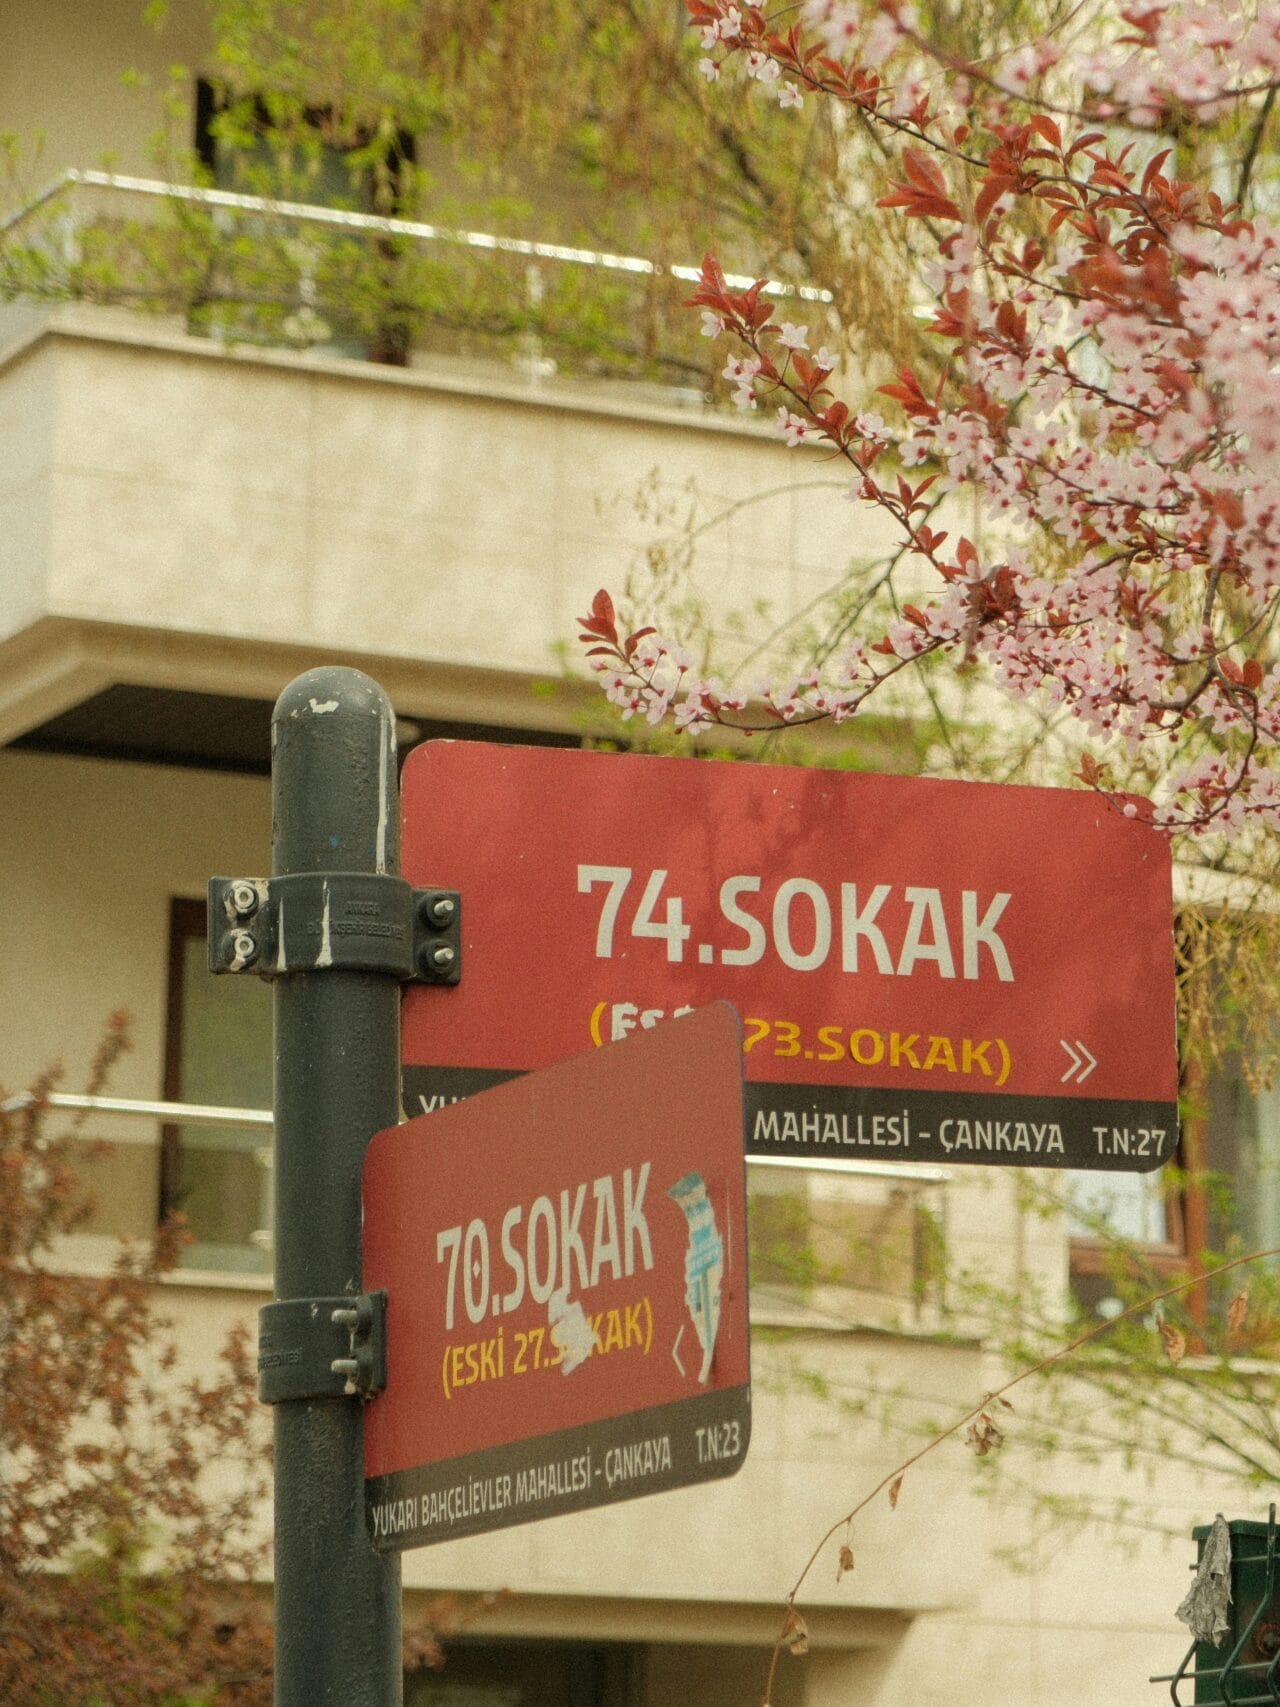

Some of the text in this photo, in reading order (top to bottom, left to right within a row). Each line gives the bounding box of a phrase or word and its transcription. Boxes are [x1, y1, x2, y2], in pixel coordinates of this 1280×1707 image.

[577, 864, 1015, 982] 74.SOKAK
[753, 1109, 909, 1147] MAHALLESİ
[939, 1119, 1064, 1153] ÇANKAYA
[1092, 1126, 1166, 1156] T.N:27
[436, 1162, 653, 1330] 70.SOKAK
[442, 1326, 504, 1399] (ESKİ
[372, 1497, 418, 1537] YUKARI
[422, 1475, 512, 1526] BAHÇELİEVLER
[516, 1447, 591, 1504] MAHALLESİ
[605, 1436, 672, 1488] ÇANKAYA
[695, 1421, 740, 1463] T.N:23
